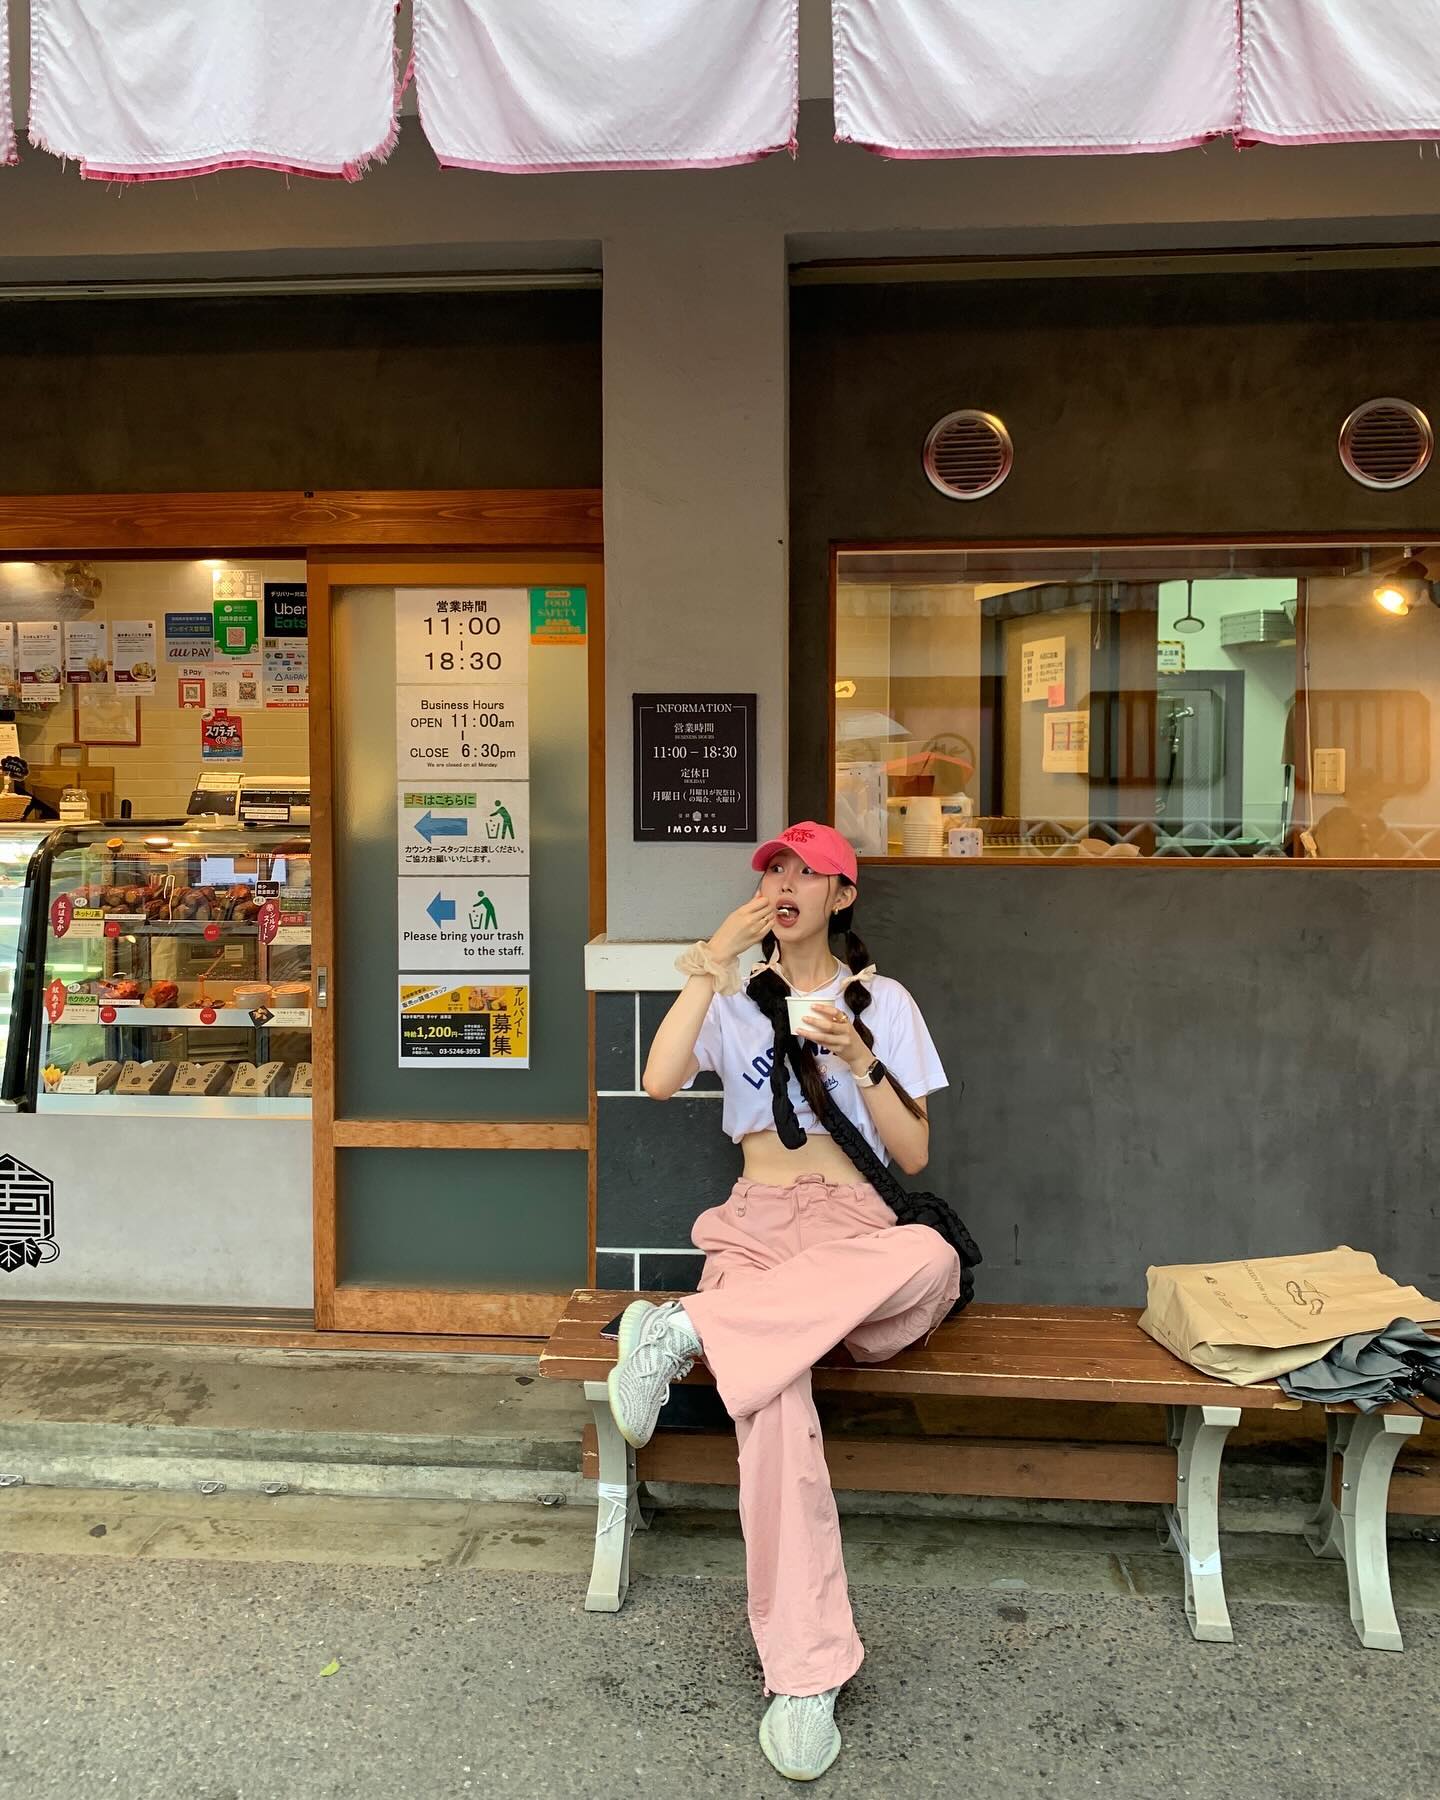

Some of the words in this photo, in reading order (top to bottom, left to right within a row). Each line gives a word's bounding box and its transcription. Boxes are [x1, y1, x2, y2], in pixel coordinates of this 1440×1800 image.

[274, 602, 307, 615] Uber
[436, 600, 488, 613] 営業時間
[544, 599, 572, 608] FOOD
[537, 608, 577, 617] SAFETY
[274, 616, 307, 629] Eats
[423, 617, 501, 636] 11:00
[169, 648, 190, 658] au
[191, 648, 211, 657] PAY
[424, 652, 502, 671] 18:30
[188, 669, 202, 677] Pay
[421, 700, 469, 710] Business
[473, 700, 505, 710] Hours
[656, 703, 733, 713] INFORMATION
[410, 718, 442, 728] OPEN
[451, 714, 515, 728] 11:00am
[205, 725, 237, 737] スクラッチ
[673, 722, 715, 733] 営業時間
[410, 748, 449, 758] CLOSE
[461, 744, 516, 759] 6:30pm
[653, 746, 688, 759] 11:00
[703, 746, 738, 759] 18:30
[680, 768, 710, 779] 定休日
[404, 793, 477, 807] ゴミはこちらに
[667, 825, 728, 833] IMOYASU
[404, 845, 525, 854] カウンタースタッフにお渡しください。
[405, 855, 492, 864] ご協力お願いいたします。
[56, 901, 66, 932] 紅はるか
[403, 931, 438, 941] Please
[440, 931, 468, 943] bring
[470, 933, 494, 943] your
[497, 931, 524, 941] trash
[464, 947, 475, 956] to
[478, 946, 495, 956] the
[498, 946, 524, 956] staff.
[51, 986, 60, 1018] 紅あずま
[513, 986, 525, 1038] アルバイト
[492, 1013, 512, 1056] 募集
